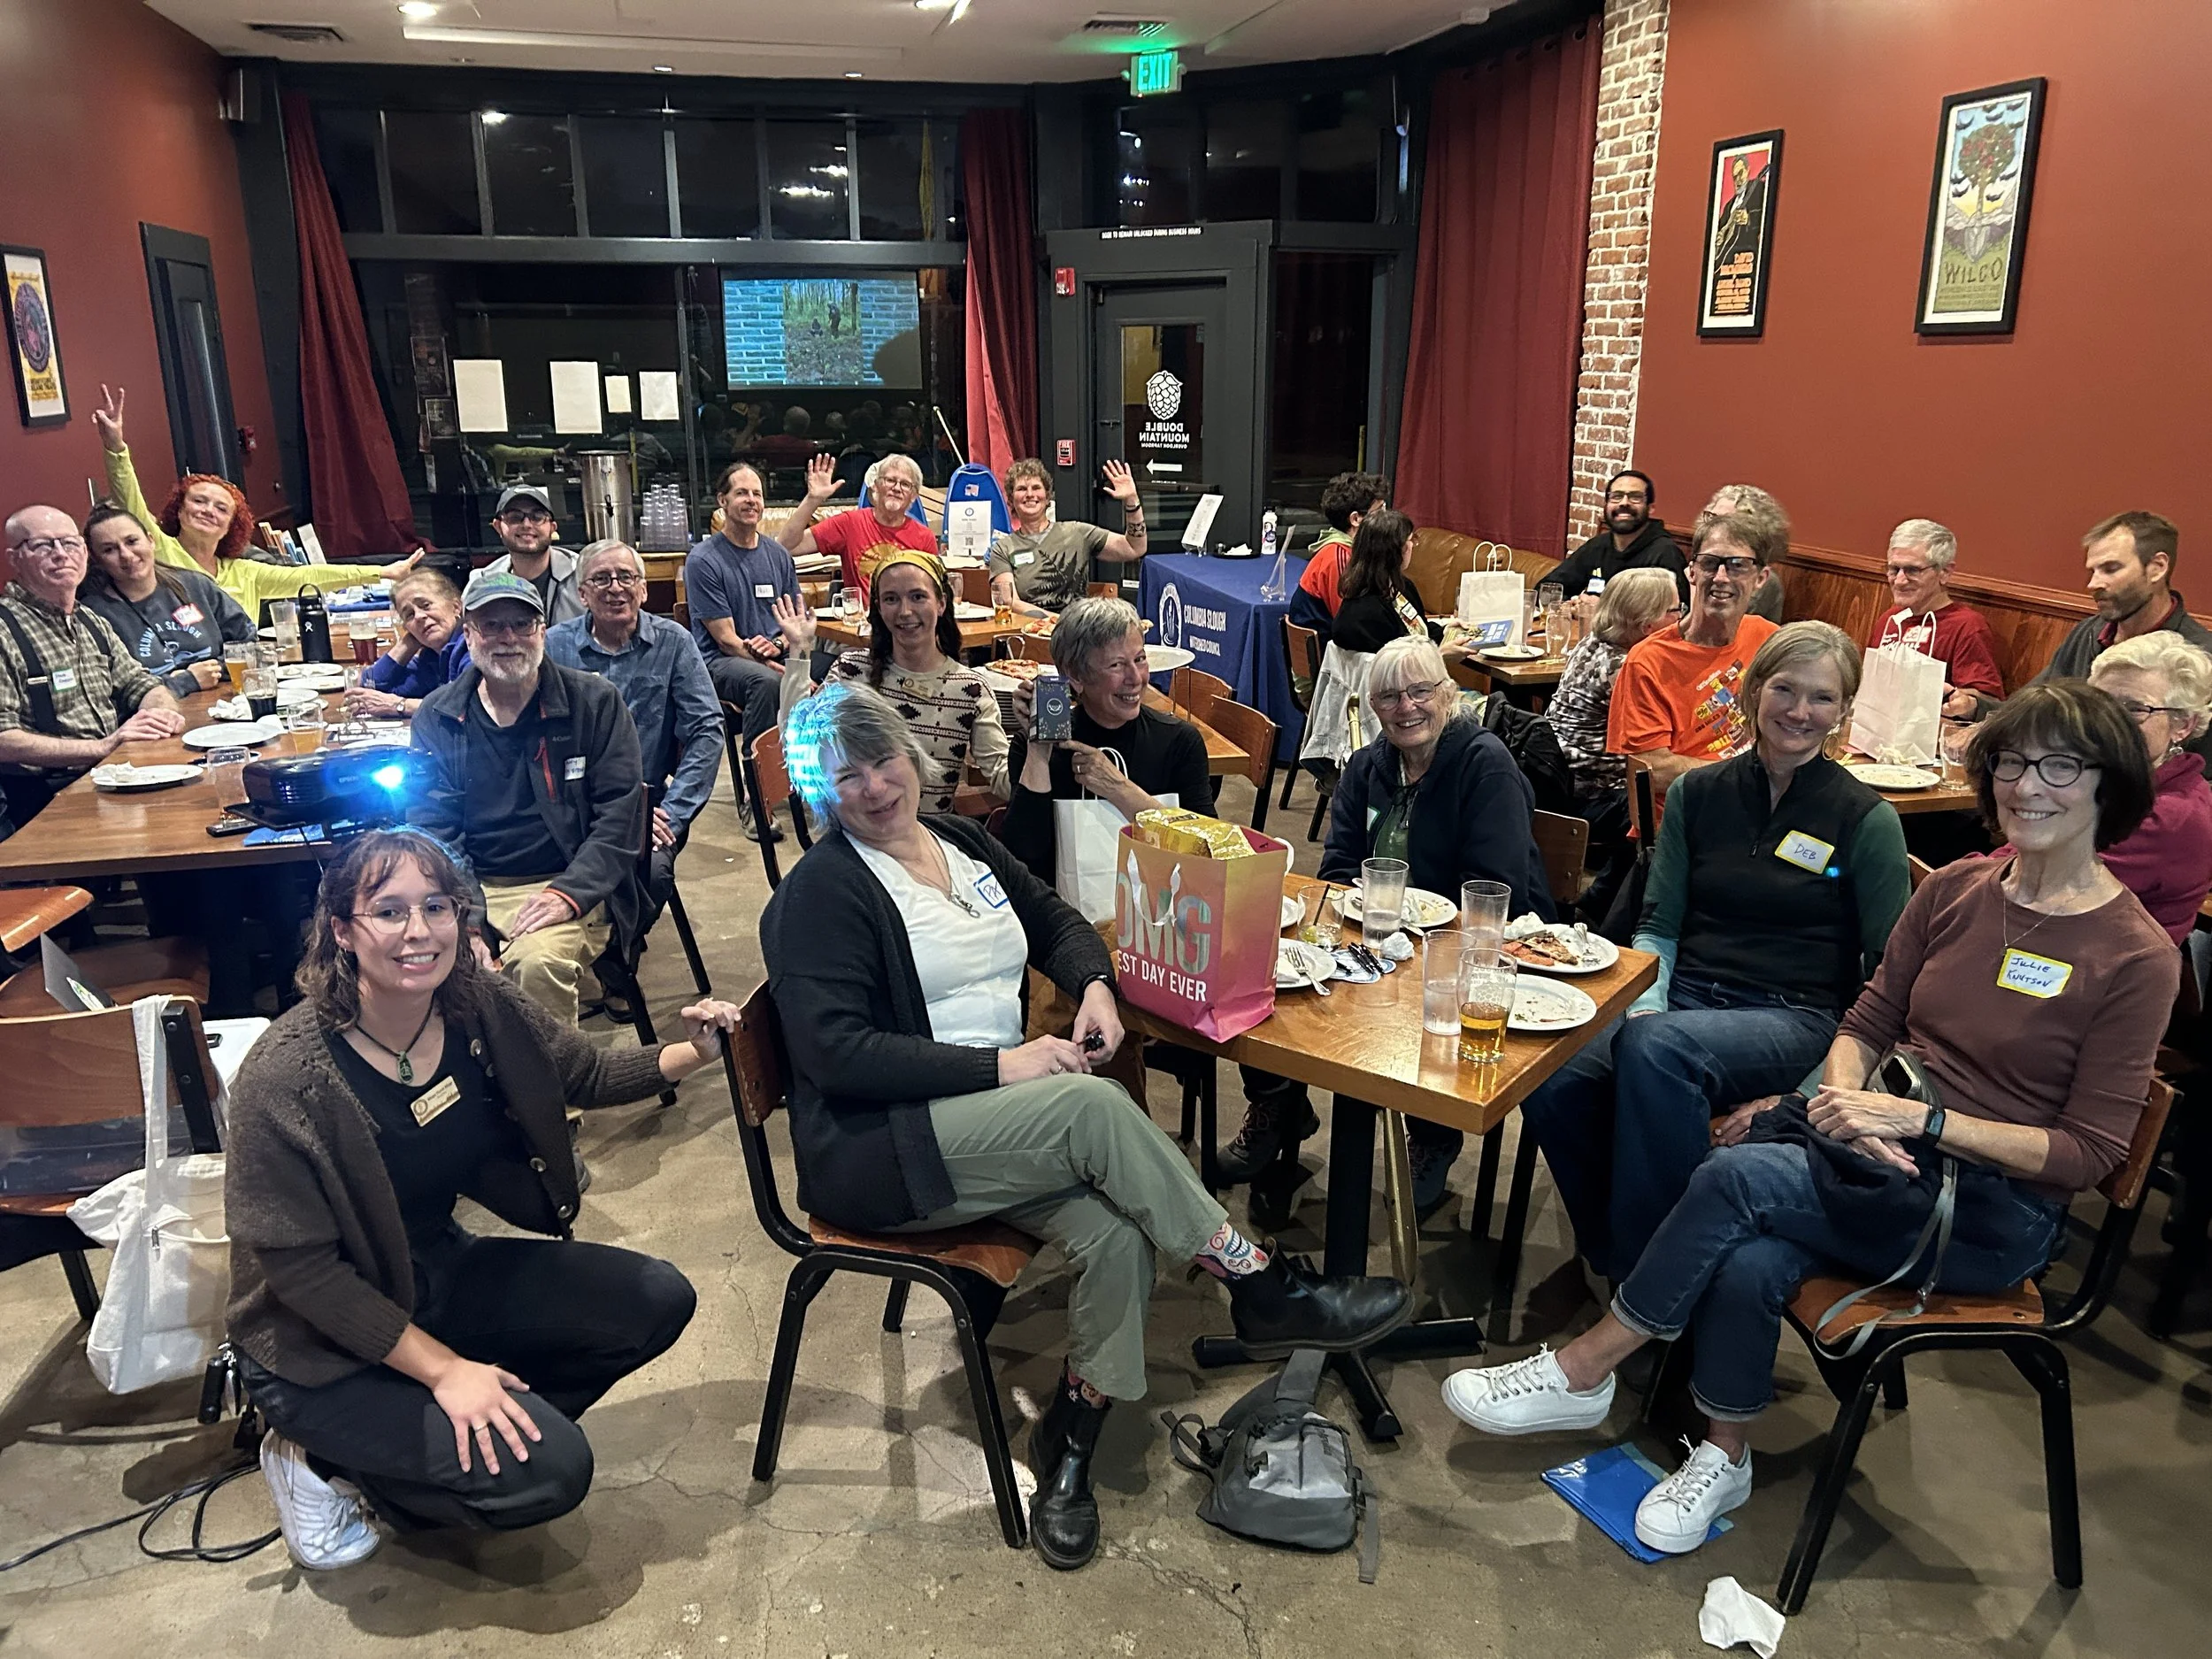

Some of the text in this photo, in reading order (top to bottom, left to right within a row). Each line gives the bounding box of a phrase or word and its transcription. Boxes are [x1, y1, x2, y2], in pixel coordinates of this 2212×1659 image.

[1138, 52, 1172, 90] EXIT
[1945, 257, 2003, 284] WILCO
[1184, 604, 1226, 632] COLUMBIA SLOUGH
[139, 623, 164, 657] COLUMA
[1706, 735, 1732, 752] 2011
[1793, 843, 1816, 860] DEB
[1117, 871, 1212, 975] OMG
[1117, 949, 1207, 1002] EST DAY EVER
[2010, 957, 2051, 972] JULIE
